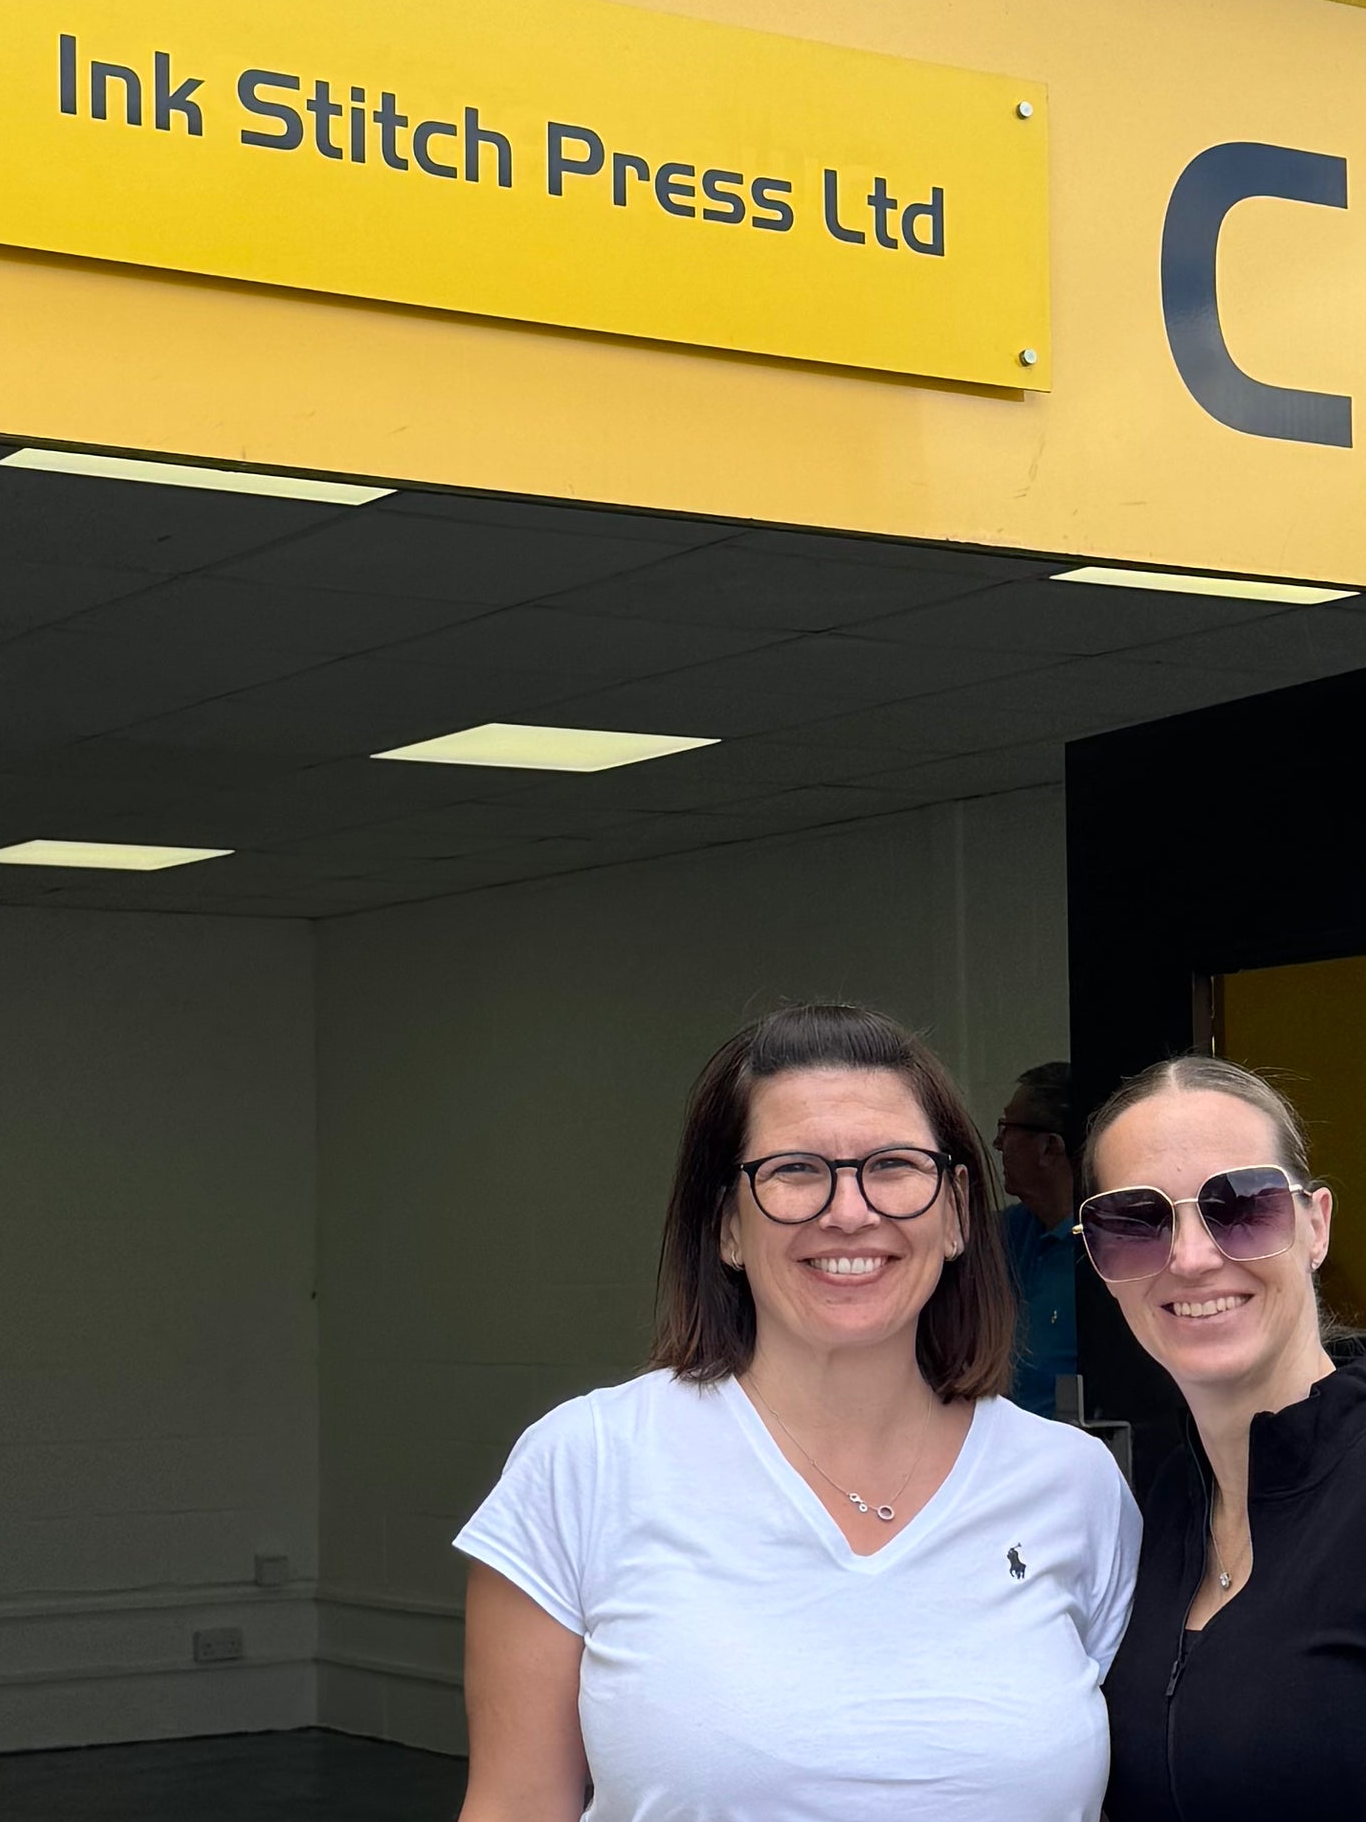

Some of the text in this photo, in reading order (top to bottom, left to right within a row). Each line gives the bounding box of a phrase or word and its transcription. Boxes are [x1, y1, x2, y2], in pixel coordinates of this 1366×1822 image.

[58, 33, 945, 258] Ink Stitch Press Ltd
